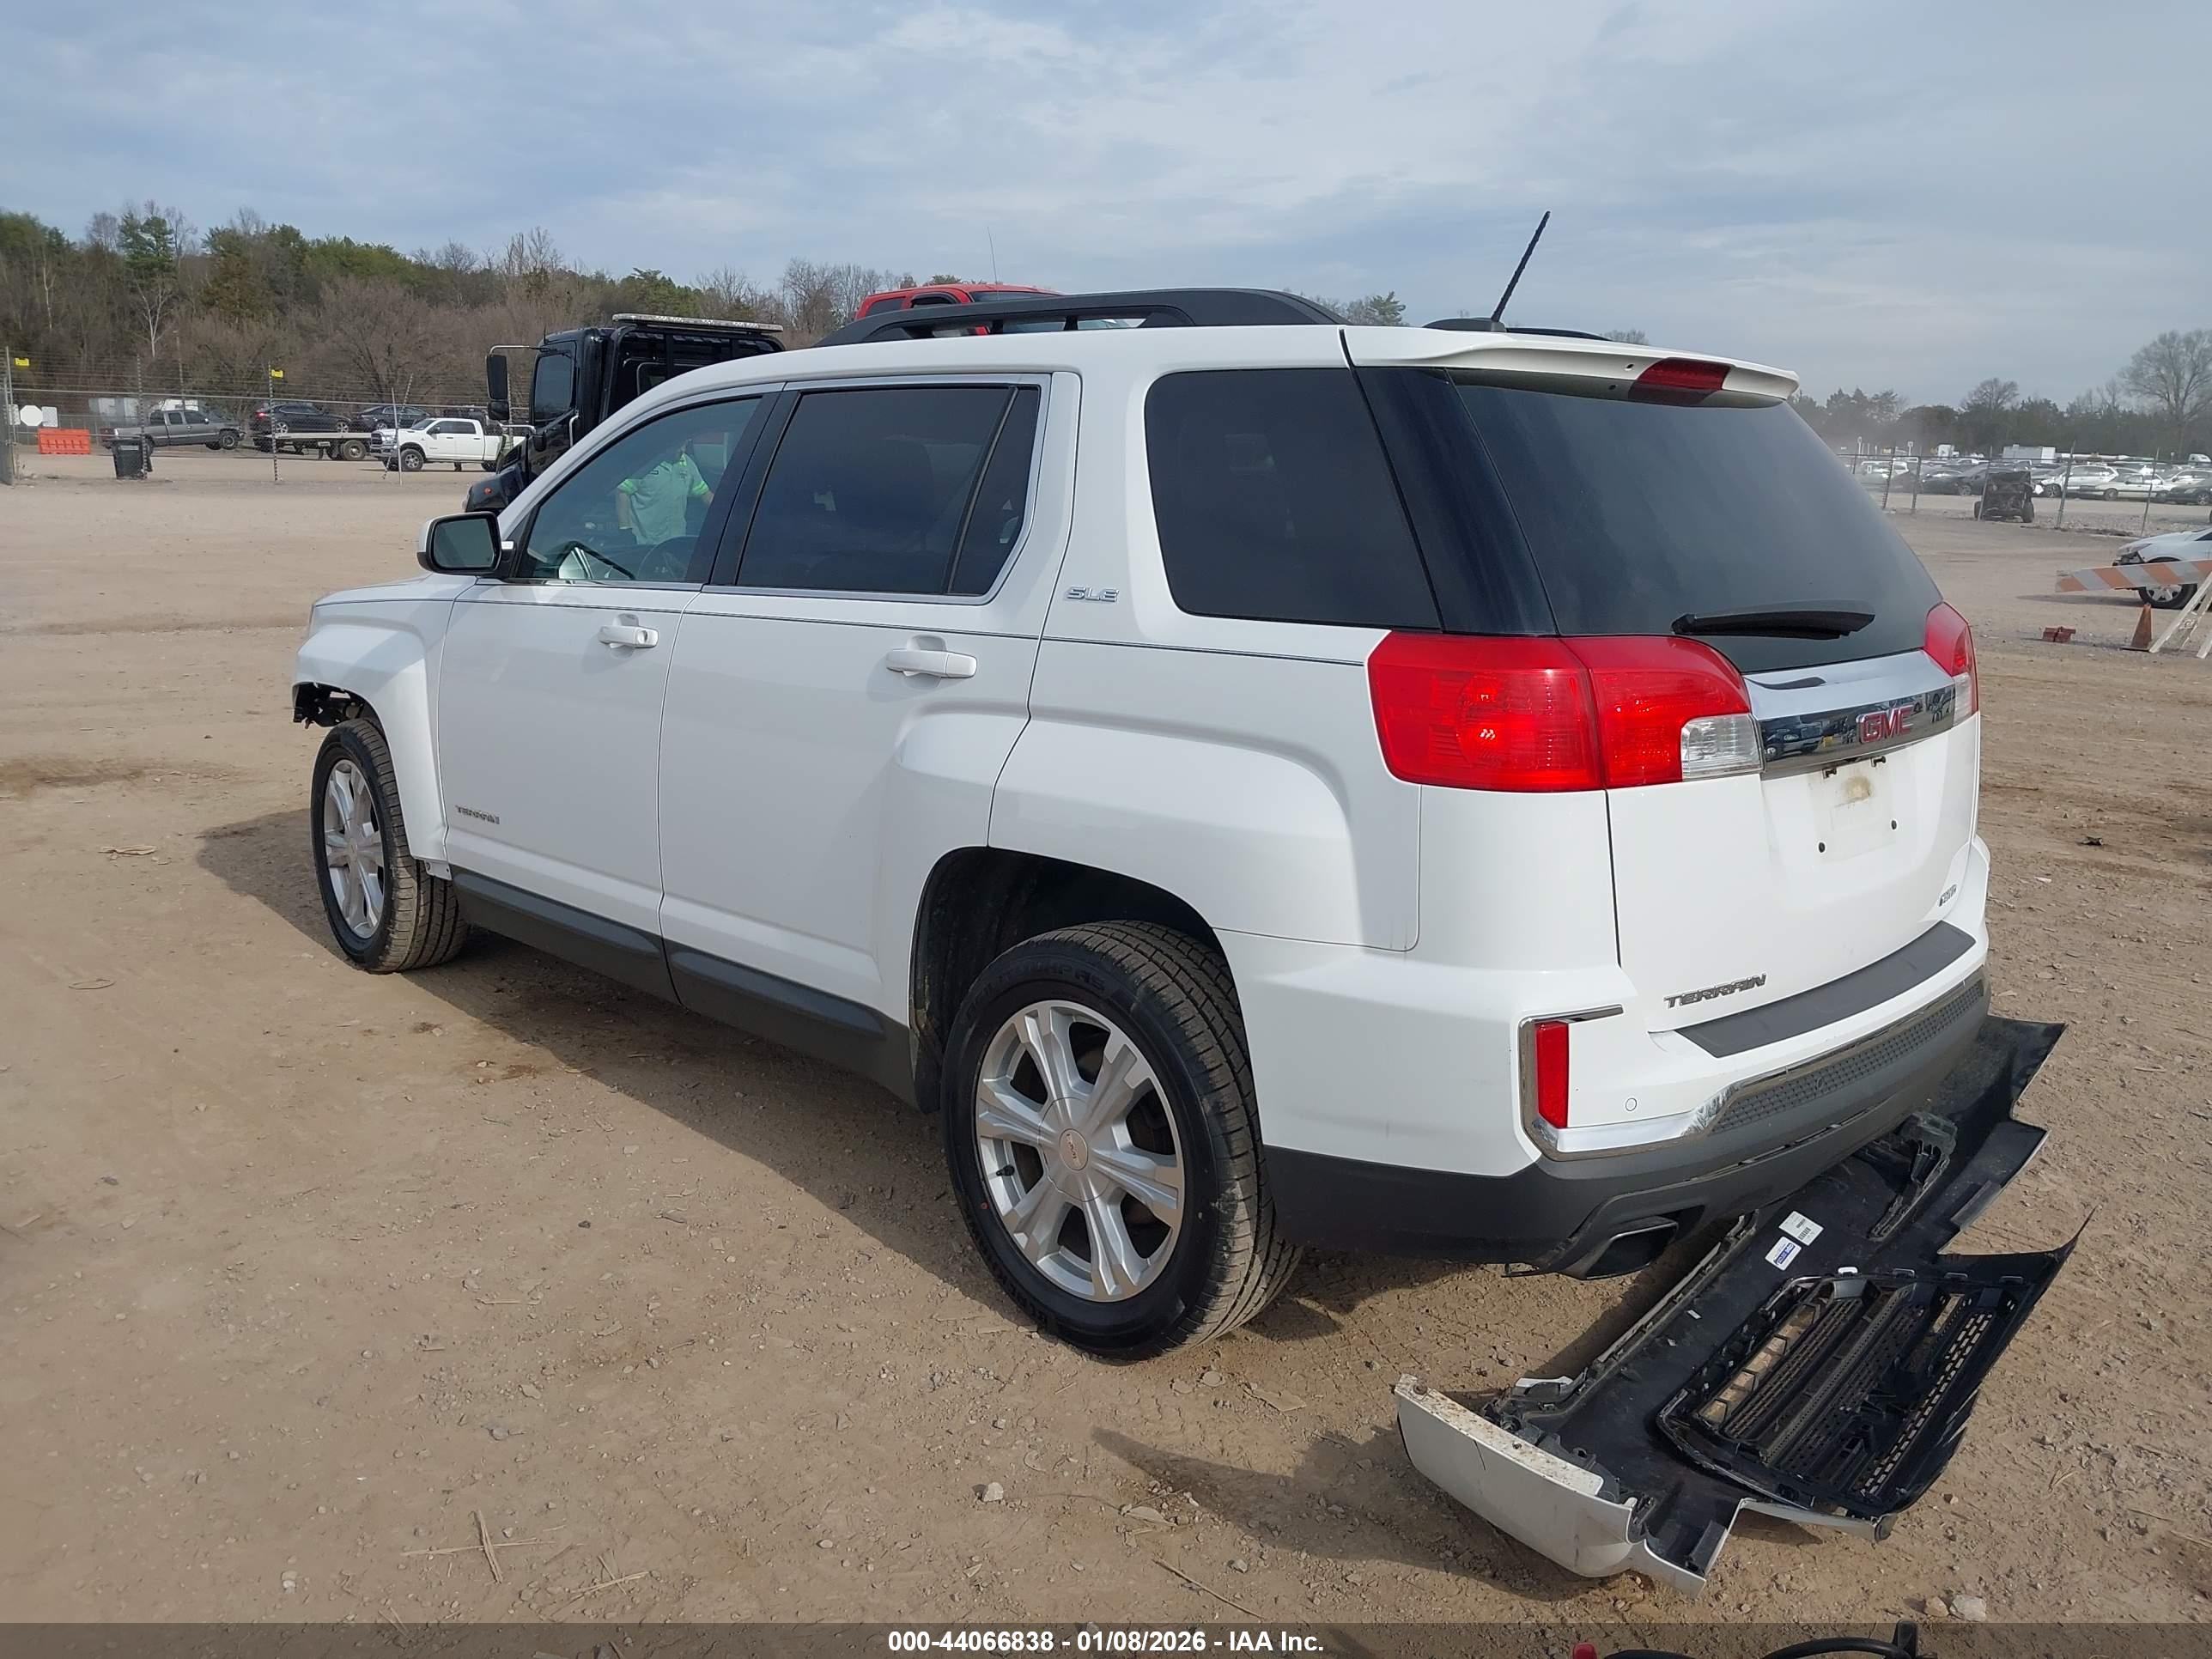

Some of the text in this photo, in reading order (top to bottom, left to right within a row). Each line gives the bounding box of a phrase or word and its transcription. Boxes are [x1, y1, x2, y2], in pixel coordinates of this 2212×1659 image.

[1066, 586, 1119, 603] SLE
[1857, 704, 1914, 743] GMC
[1663, 973, 1767, 1009] TERRAIN
